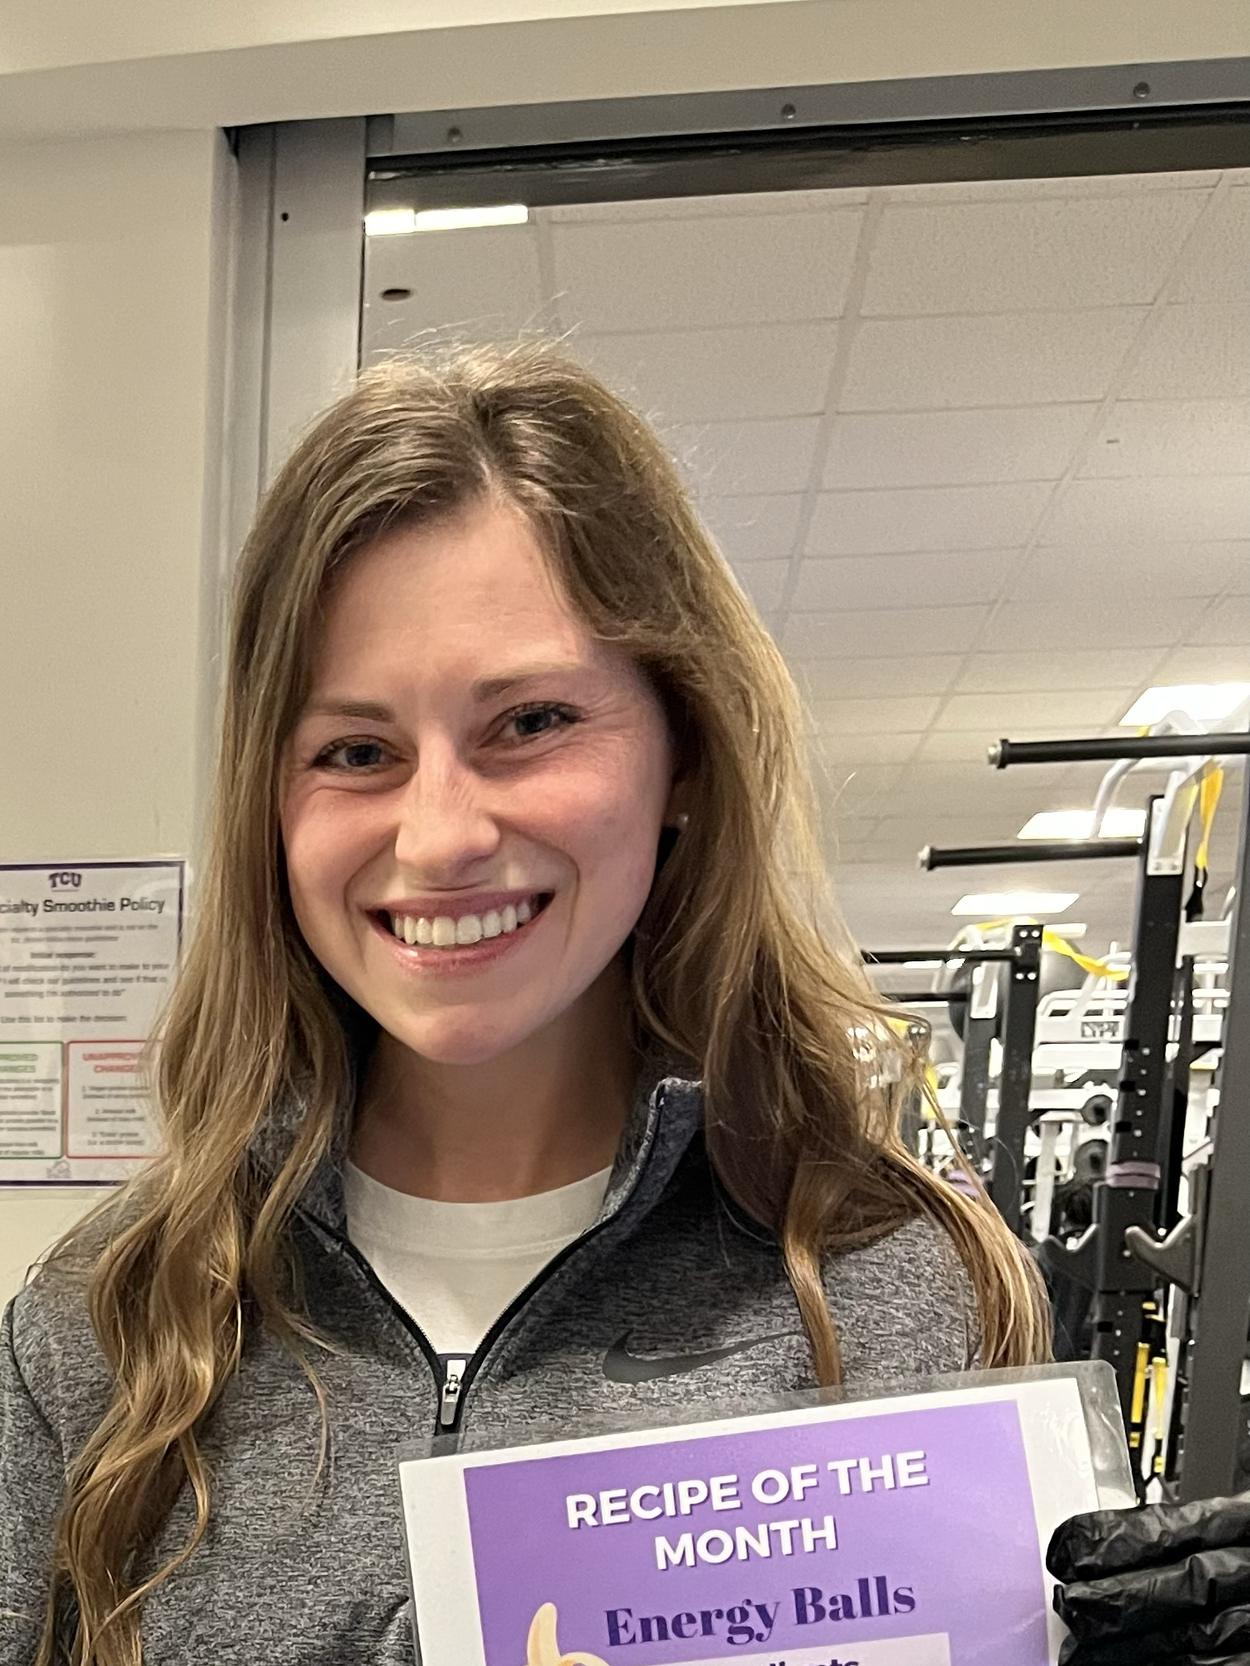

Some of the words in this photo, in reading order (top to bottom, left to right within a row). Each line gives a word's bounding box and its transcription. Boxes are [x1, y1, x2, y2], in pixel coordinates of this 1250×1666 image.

[43, 898, 115, 913] Smoothie
[120, 897, 165, 914] Policy
[49, 872, 82, 888] TCU
[566, 1474, 741, 1529] RECIPE
[751, 1463, 818, 1505] OF
[827, 1450, 930, 1495] THE
[654, 1516, 837, 1570] MONTH
[605, 1598, 780, 1647] Energy
[791, 1575, 916, 1626] Balls
